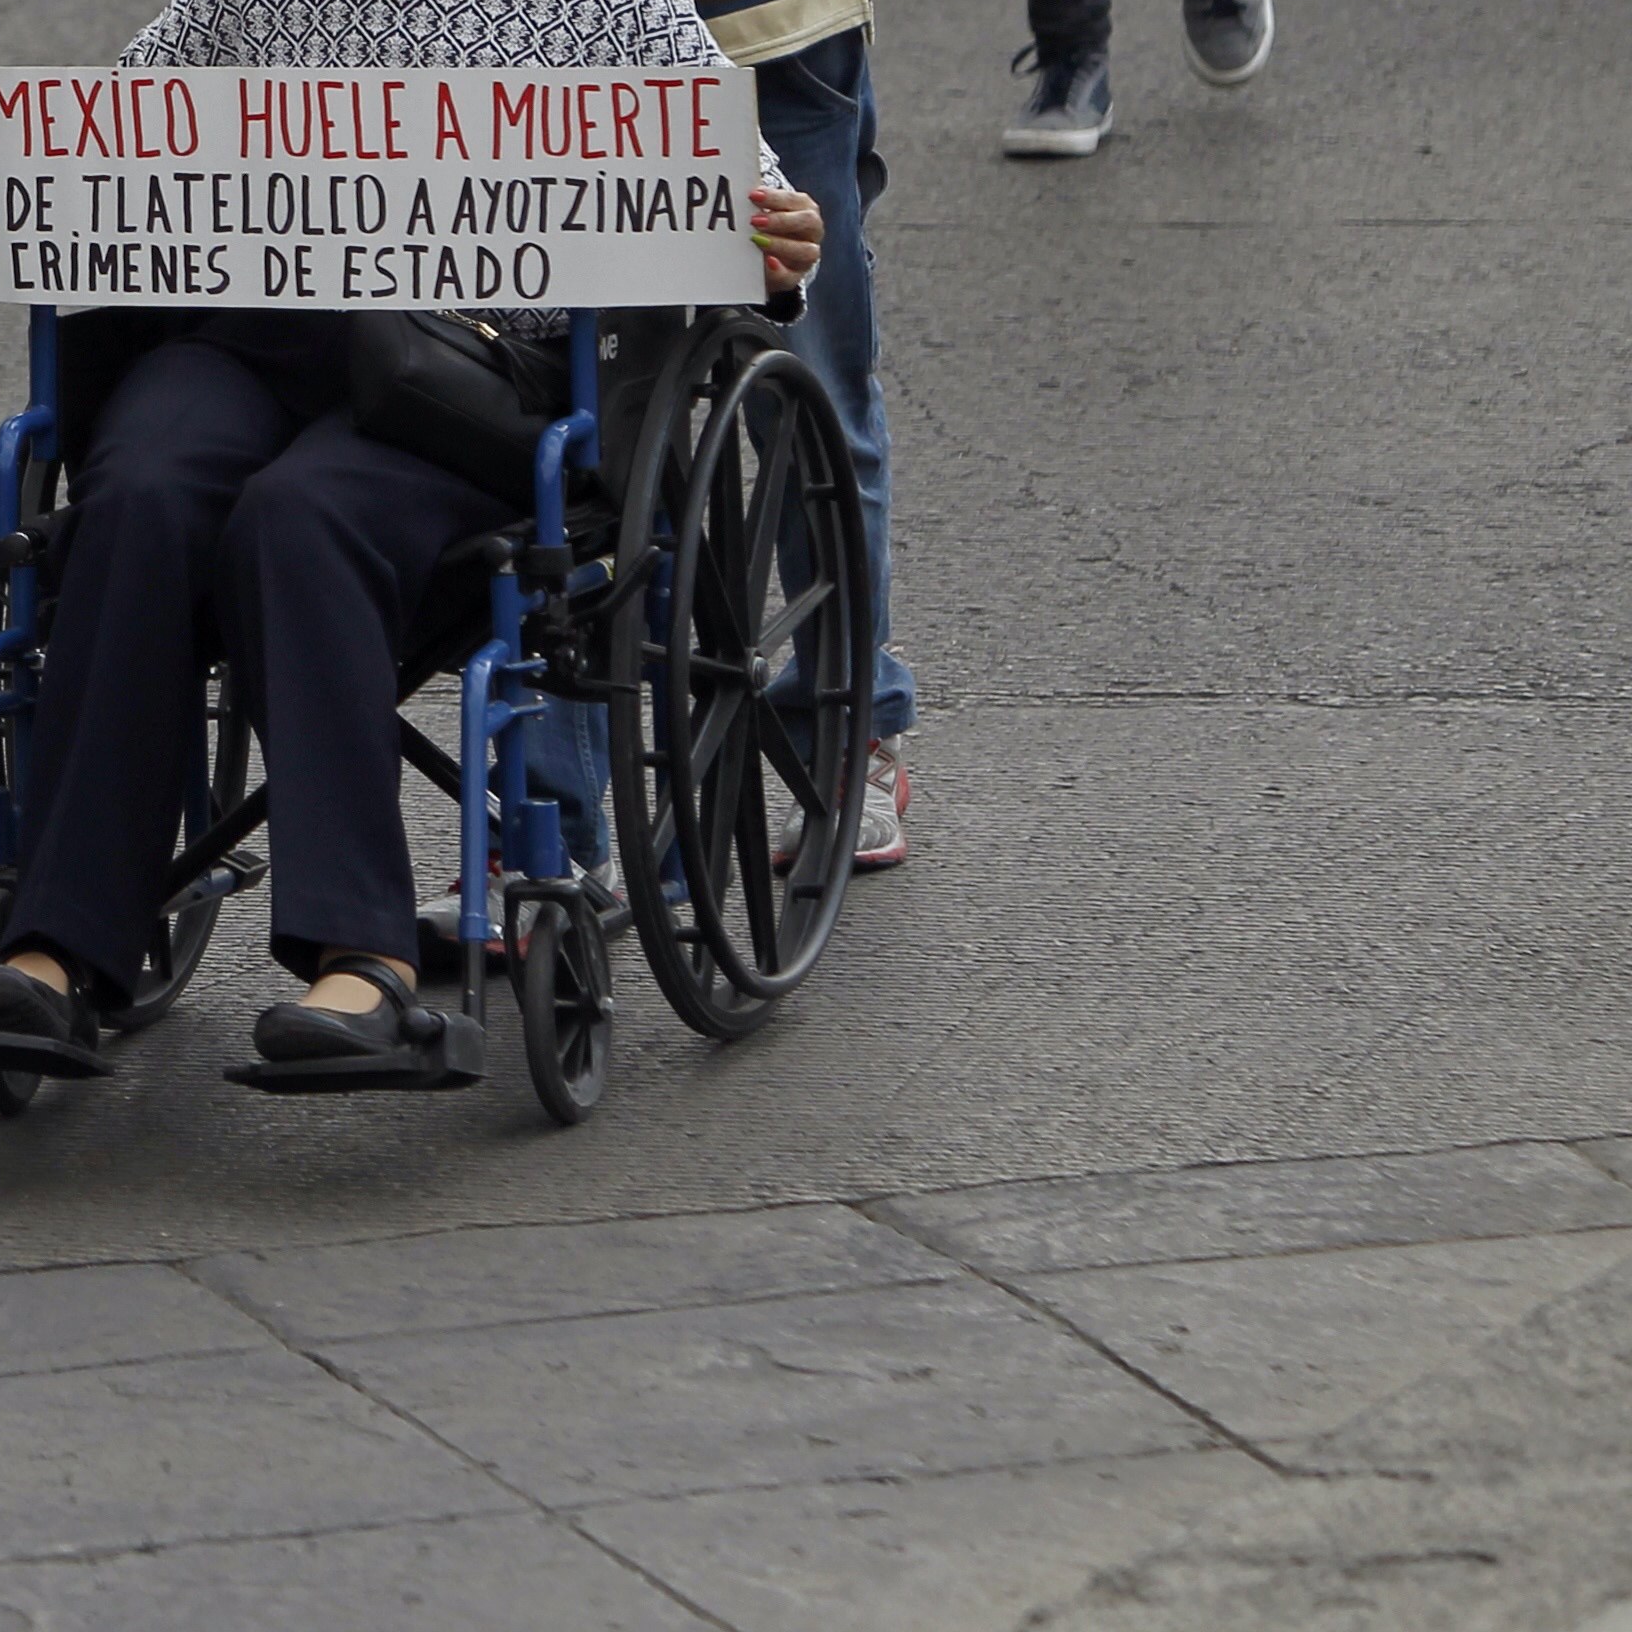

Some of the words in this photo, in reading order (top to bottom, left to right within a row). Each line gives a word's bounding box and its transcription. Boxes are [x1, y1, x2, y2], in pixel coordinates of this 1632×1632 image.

[238, 79, 408, 160] HUELE
[436, 82, 469, 160] A
[492, 77, 721, 160] MUERTE
[6, 176, 55, 232] DE
[82, 172, 388, 236] TLATELOLCO
[406, 176, 435, 236] A
[450, 170, 737, 235] AYOTZINAPA
[263, 243, 317, 298] DE
[342, 243, 552, 301] ESTADO
